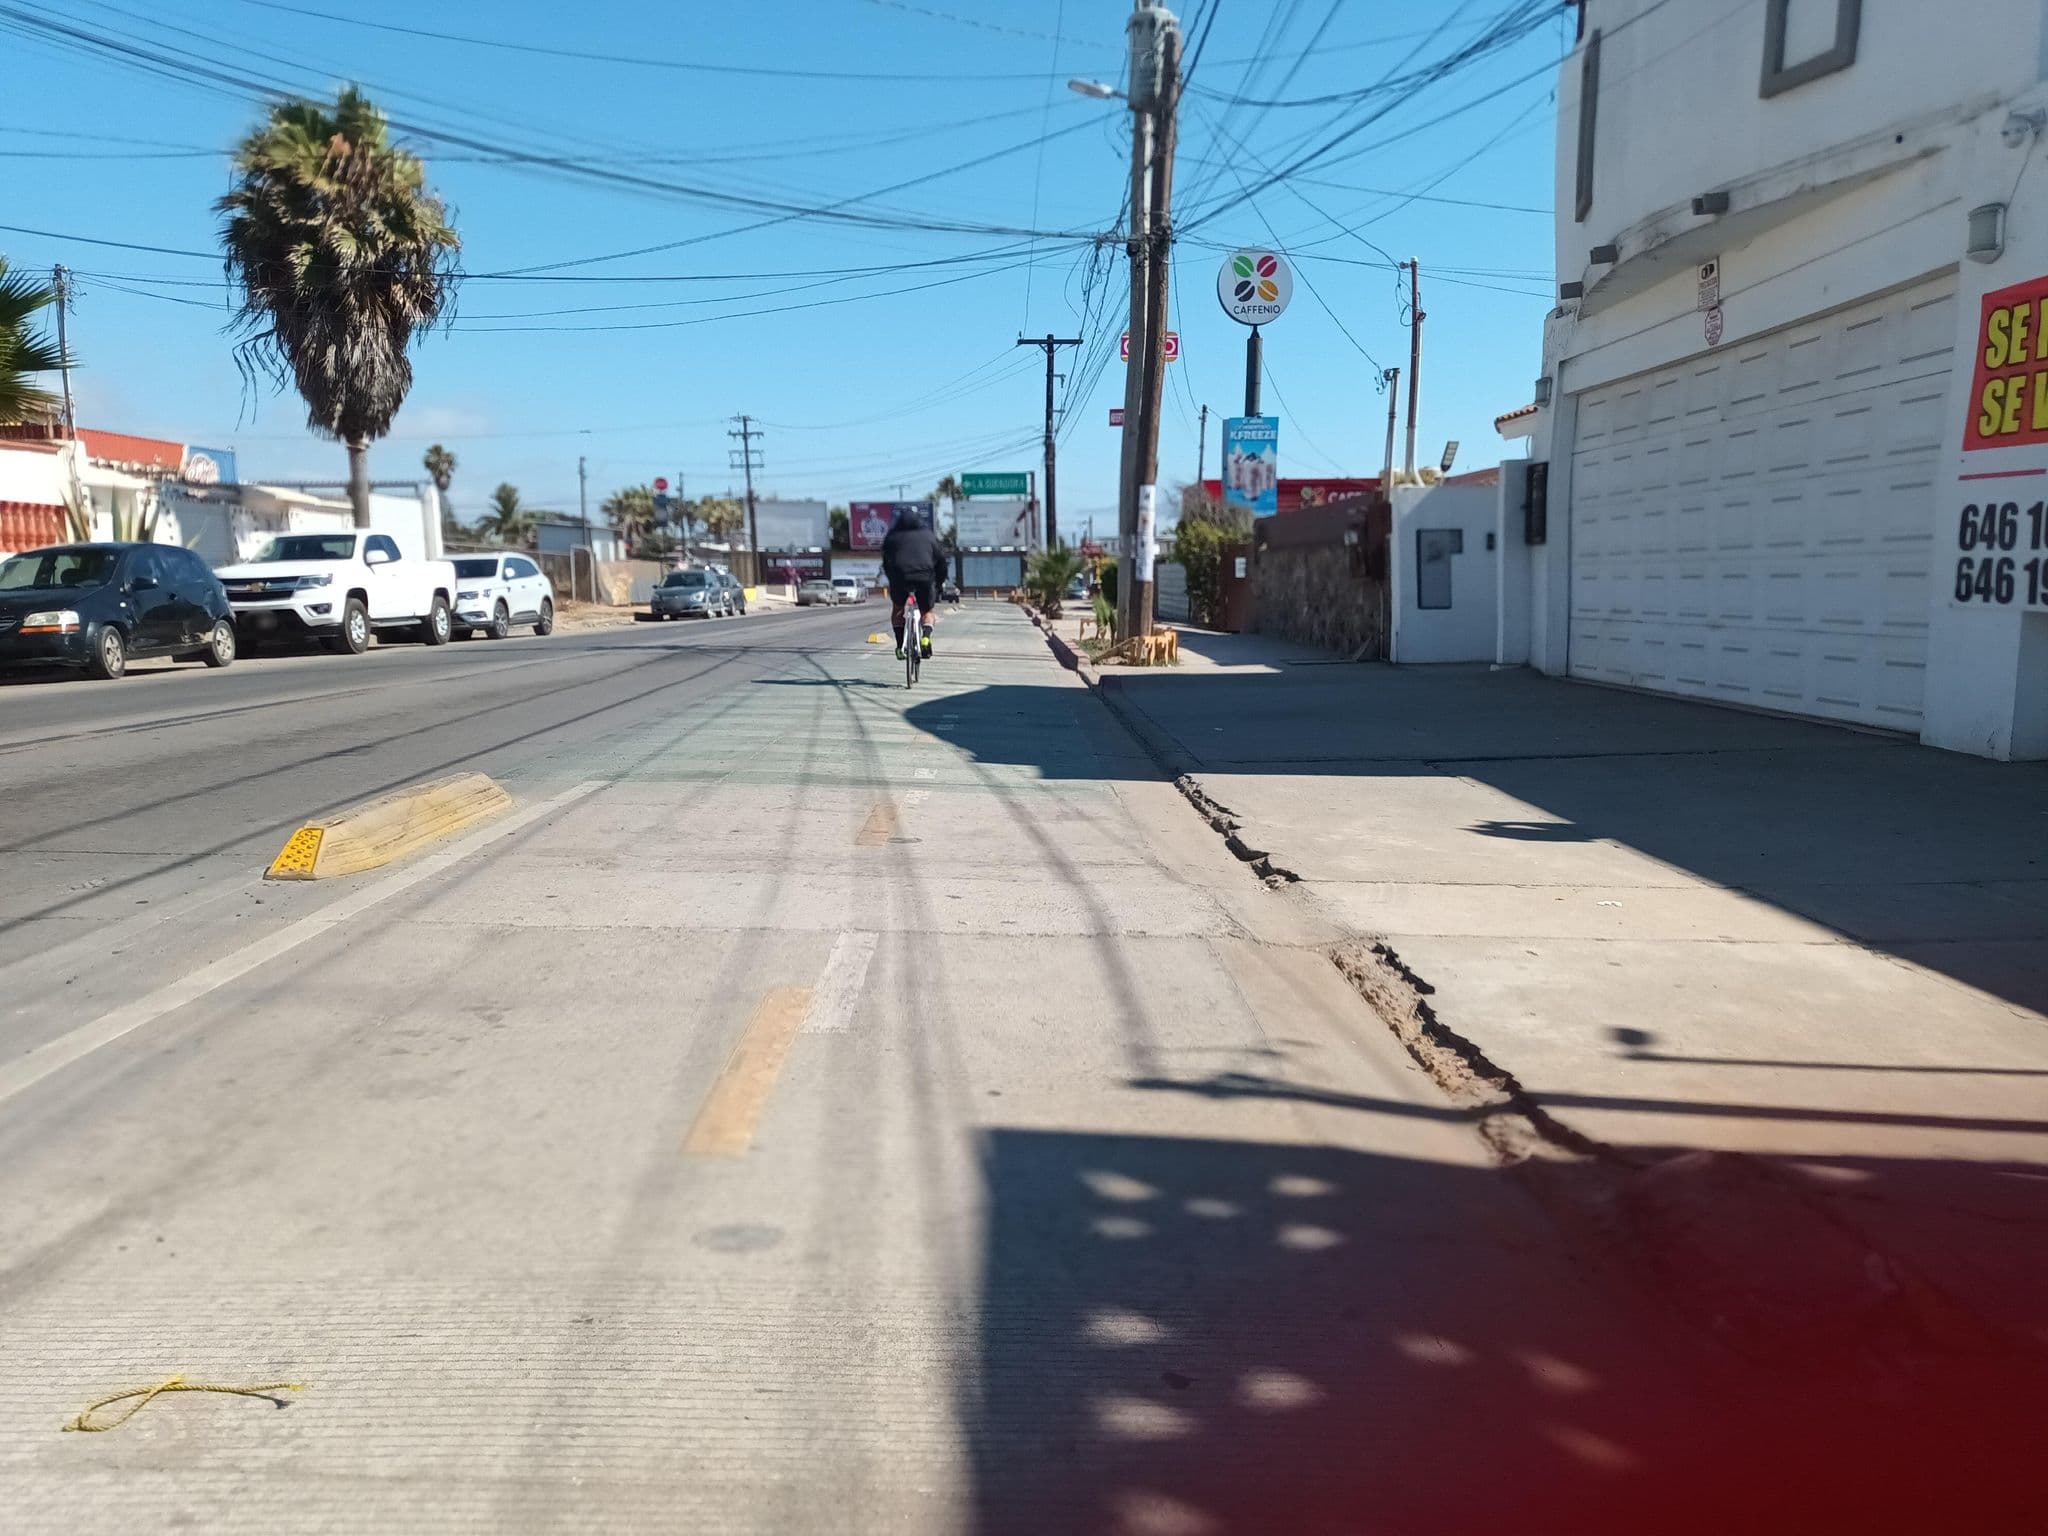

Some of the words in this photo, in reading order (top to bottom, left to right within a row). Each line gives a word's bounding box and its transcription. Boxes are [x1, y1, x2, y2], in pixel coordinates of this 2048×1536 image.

[1233, 304, 1281, 315] CAFFENIO
[1984, 303, 2031, 369] SE
[1978, 375, 2027, 437] SE
[1959, 502, 2019, 551] 646
[1955, 556, 2015, 604] 646
